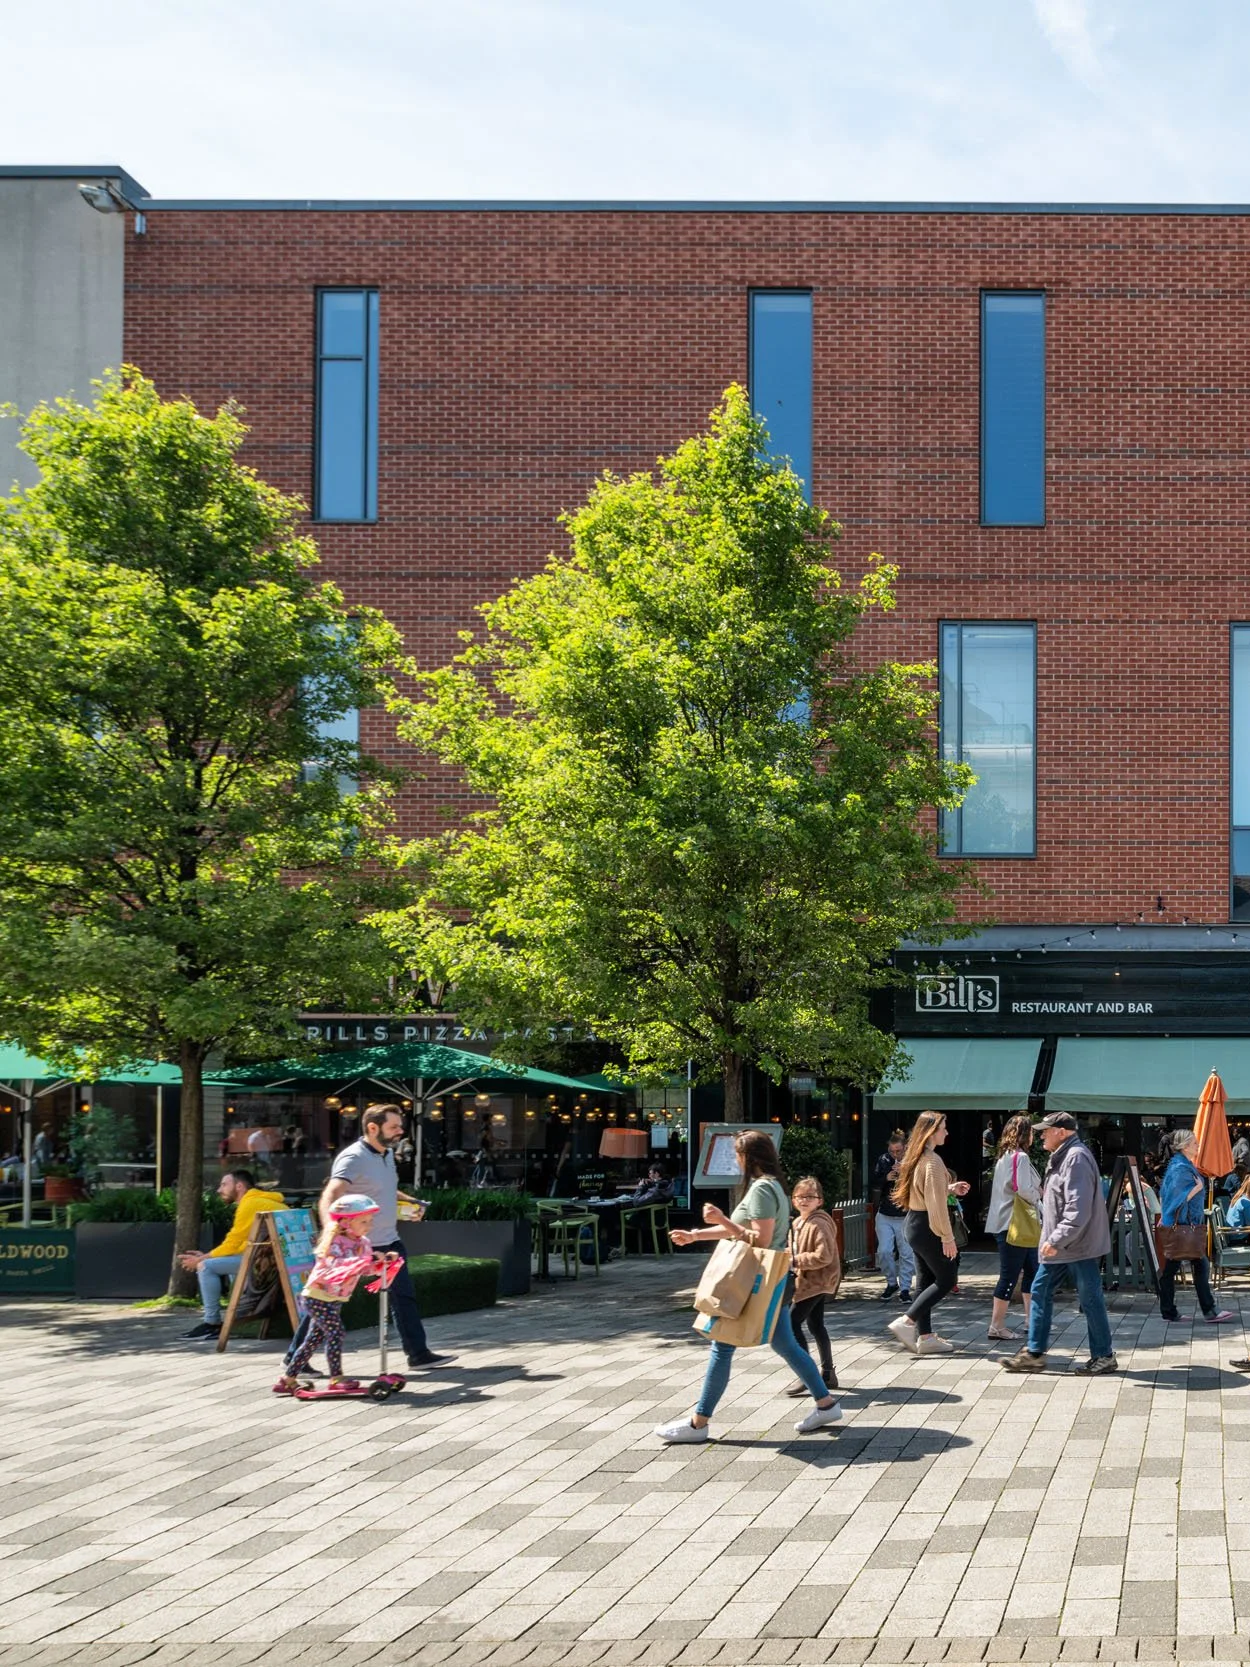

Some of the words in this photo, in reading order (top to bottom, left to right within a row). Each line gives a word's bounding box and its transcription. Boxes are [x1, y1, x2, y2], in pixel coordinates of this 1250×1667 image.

[924, 975, 993, 1013] Bill's
[1011, 1002, 1093, 1014] RESTAURANT
[1096, 1002, 1125, 1014] AND
[1128, 1002, 1154, 1014] BAR
[287, 1026, 389, 1041] RILLS
[404, 1026, 487, 1041] PIZZA
